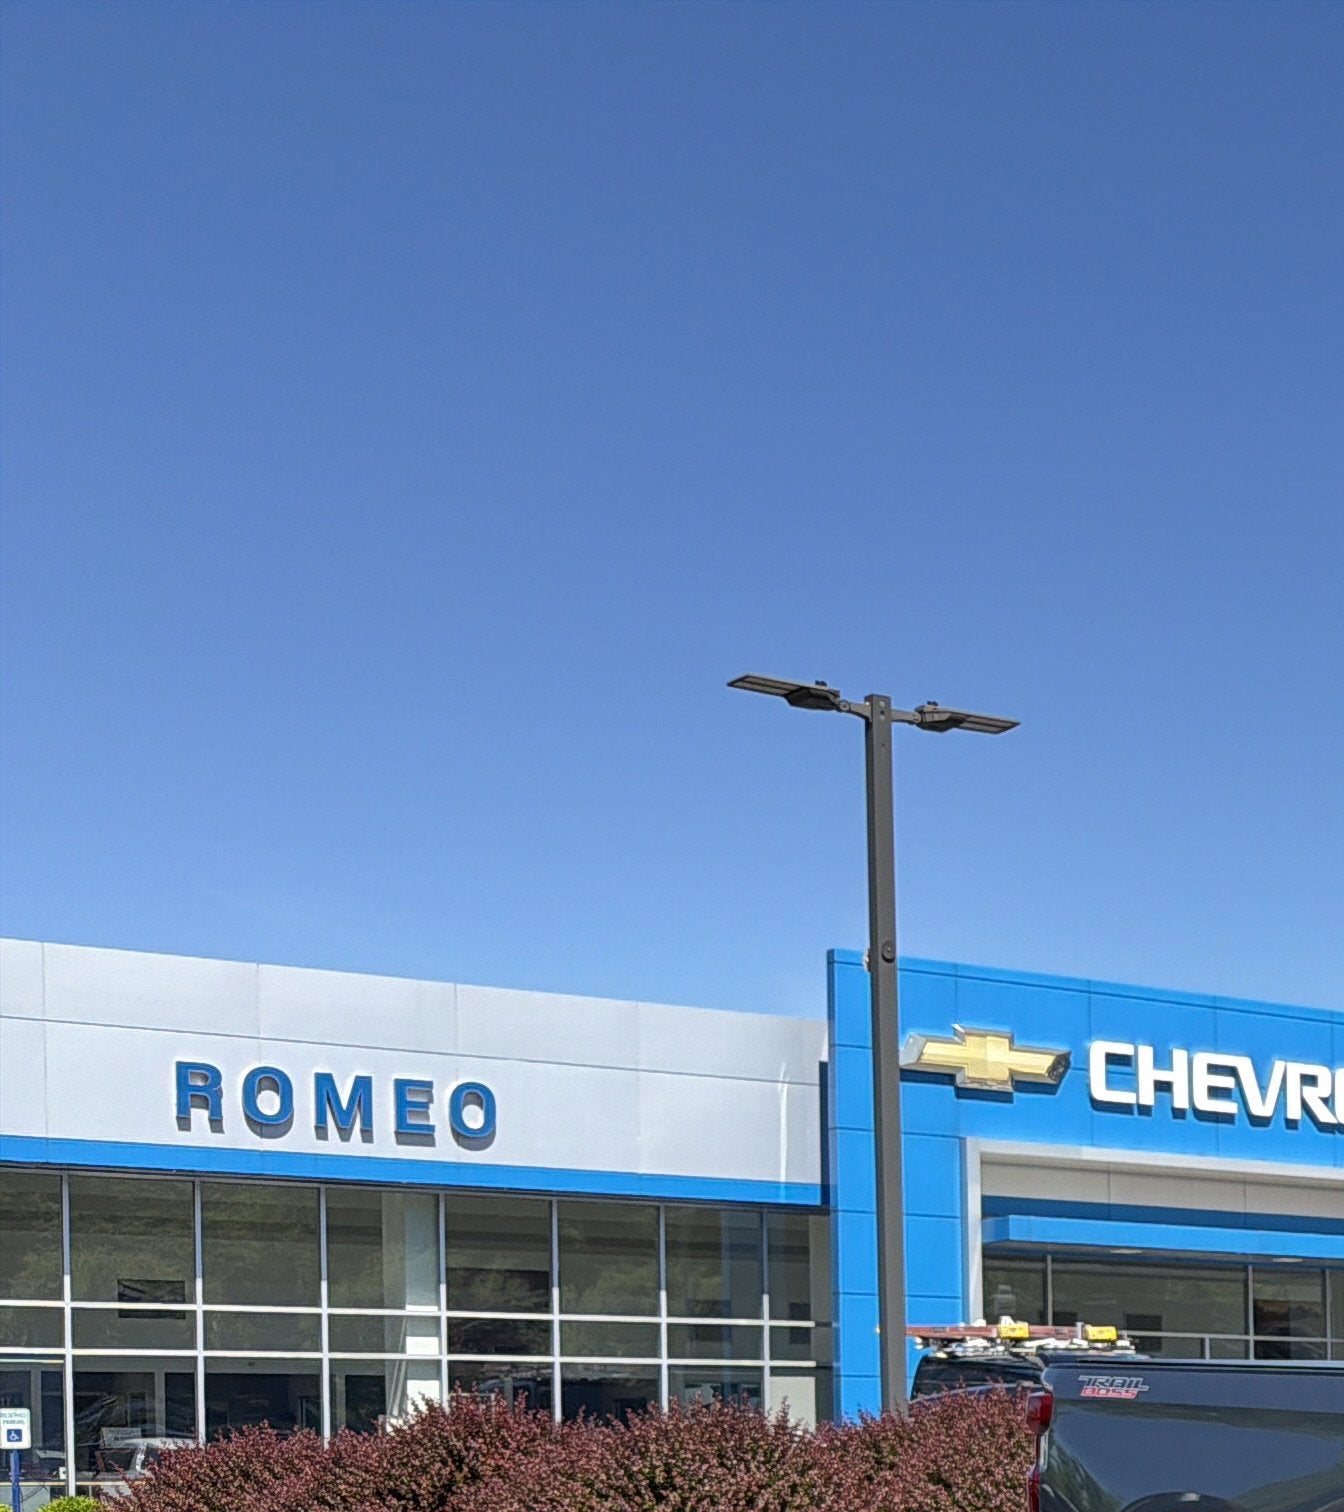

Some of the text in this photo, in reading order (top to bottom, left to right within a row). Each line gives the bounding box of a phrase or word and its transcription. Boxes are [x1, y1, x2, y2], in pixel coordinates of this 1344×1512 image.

[175, 1060, 497, 1139] ROMEO
[1078, 1375, 1150, 1392] TRAIL
[1080, 1387, 1138, 1400] BOSS
